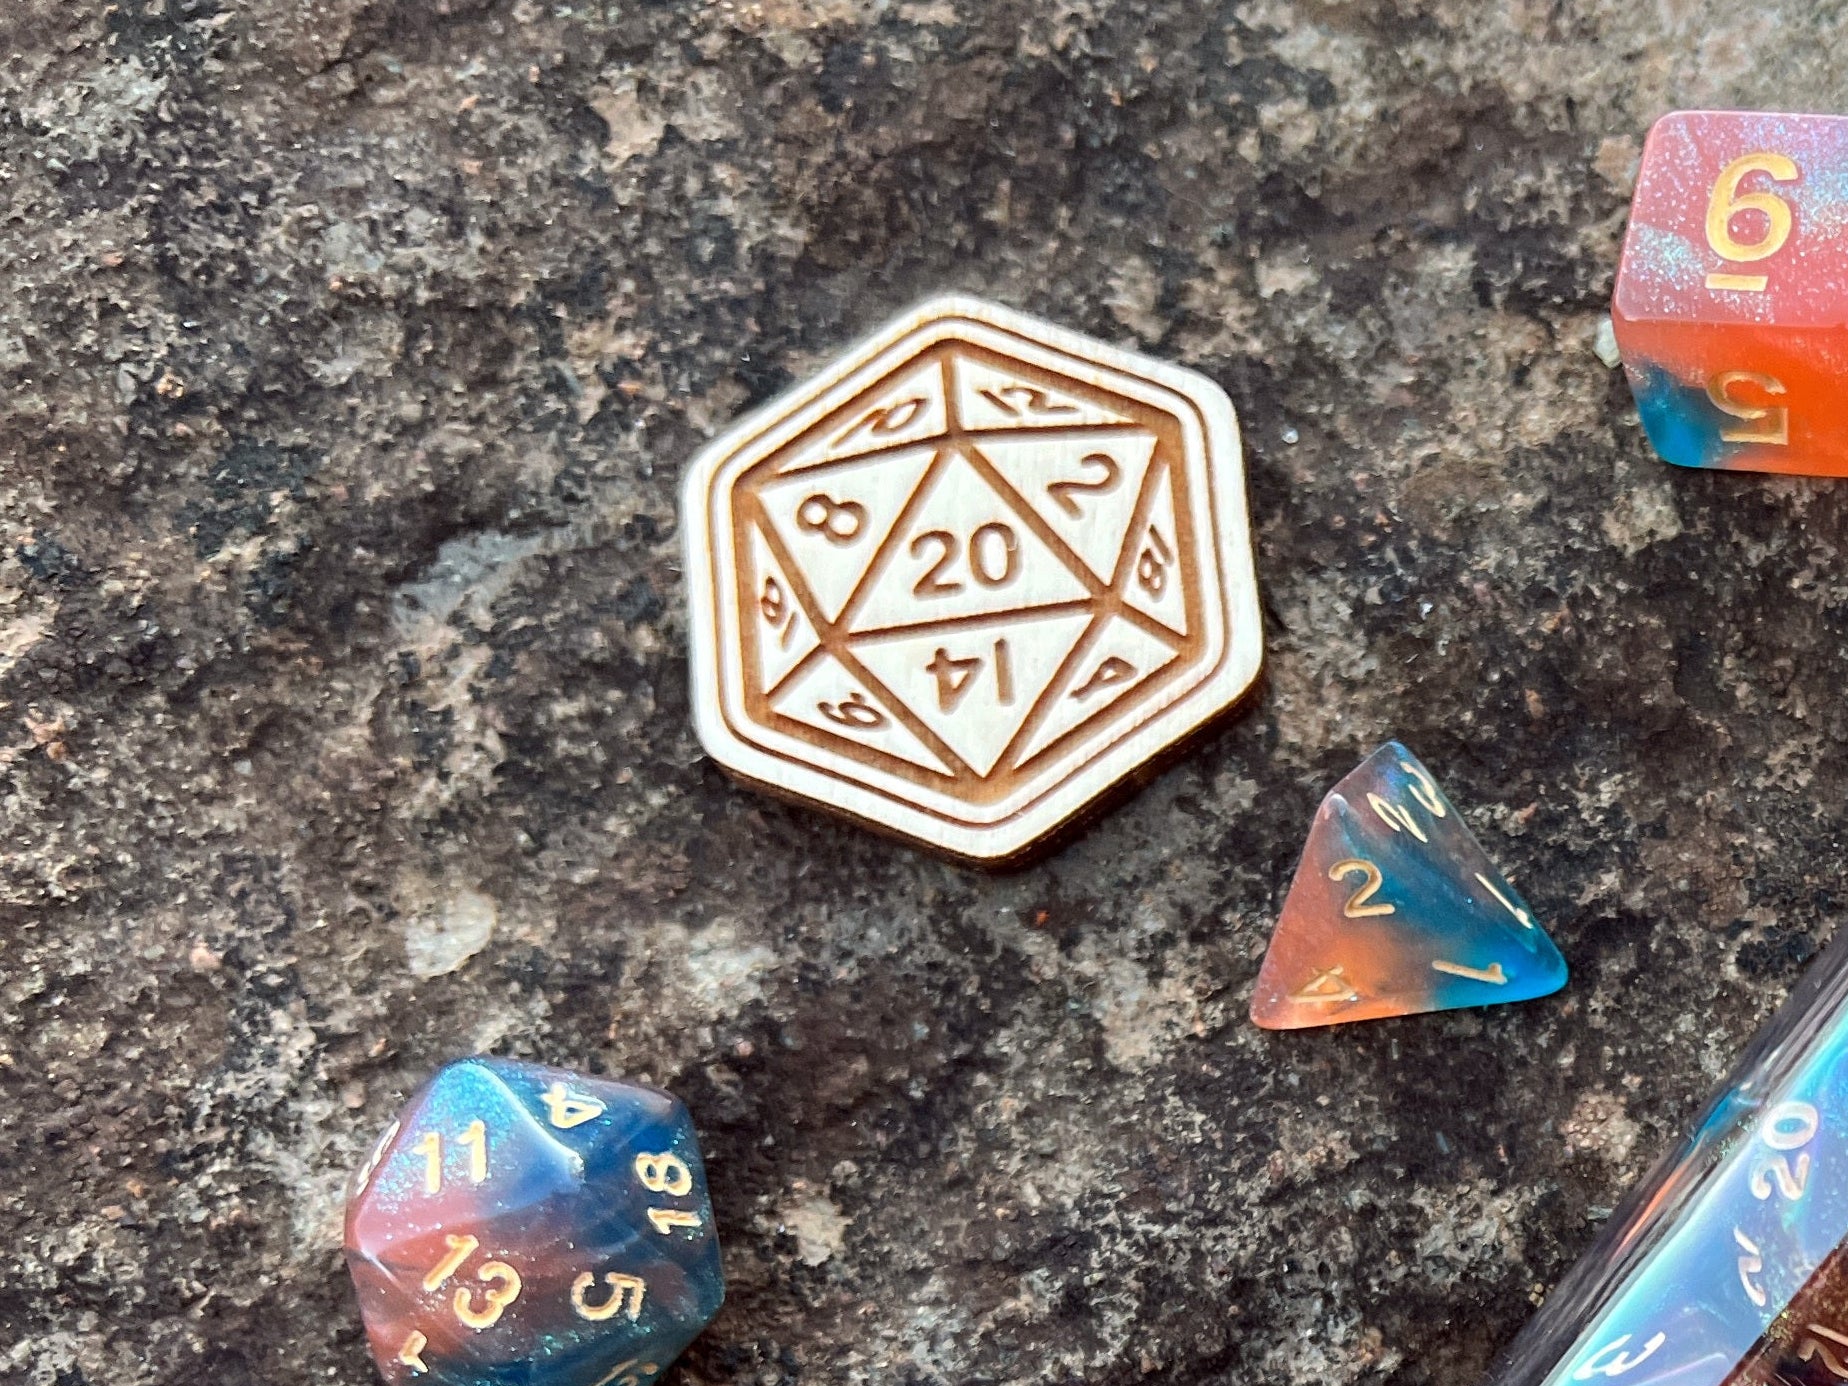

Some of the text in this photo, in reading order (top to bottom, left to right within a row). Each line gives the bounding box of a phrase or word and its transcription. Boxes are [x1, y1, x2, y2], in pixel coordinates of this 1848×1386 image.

[1705, 152, 1798, 291] 6
[829, 396, 929, 449] 10
[977, 385, 1079, 416] 12
[1707, 370, 1788, 446] 5
[796, 494, 868, 542] 8
[1047, 453, 1119, 520] 2
[909, 521, 1021, 598] 20
[1135, 525, 1174, 595] 18
[925, 638, 1015, 714] 14
[1071, 656, 1136, 699] 4
[1329, 859, 1396, 918] 2
[541, 1081, 607, 1129] 4
[411, 1118, 488, 1195] 11
[1749, 1101, 1819, 1201] 20
[634, 1151, 702, 1236] 18
[422, 1234, 523, 1329] 13
[570, 1270, 646, 1322] 5
